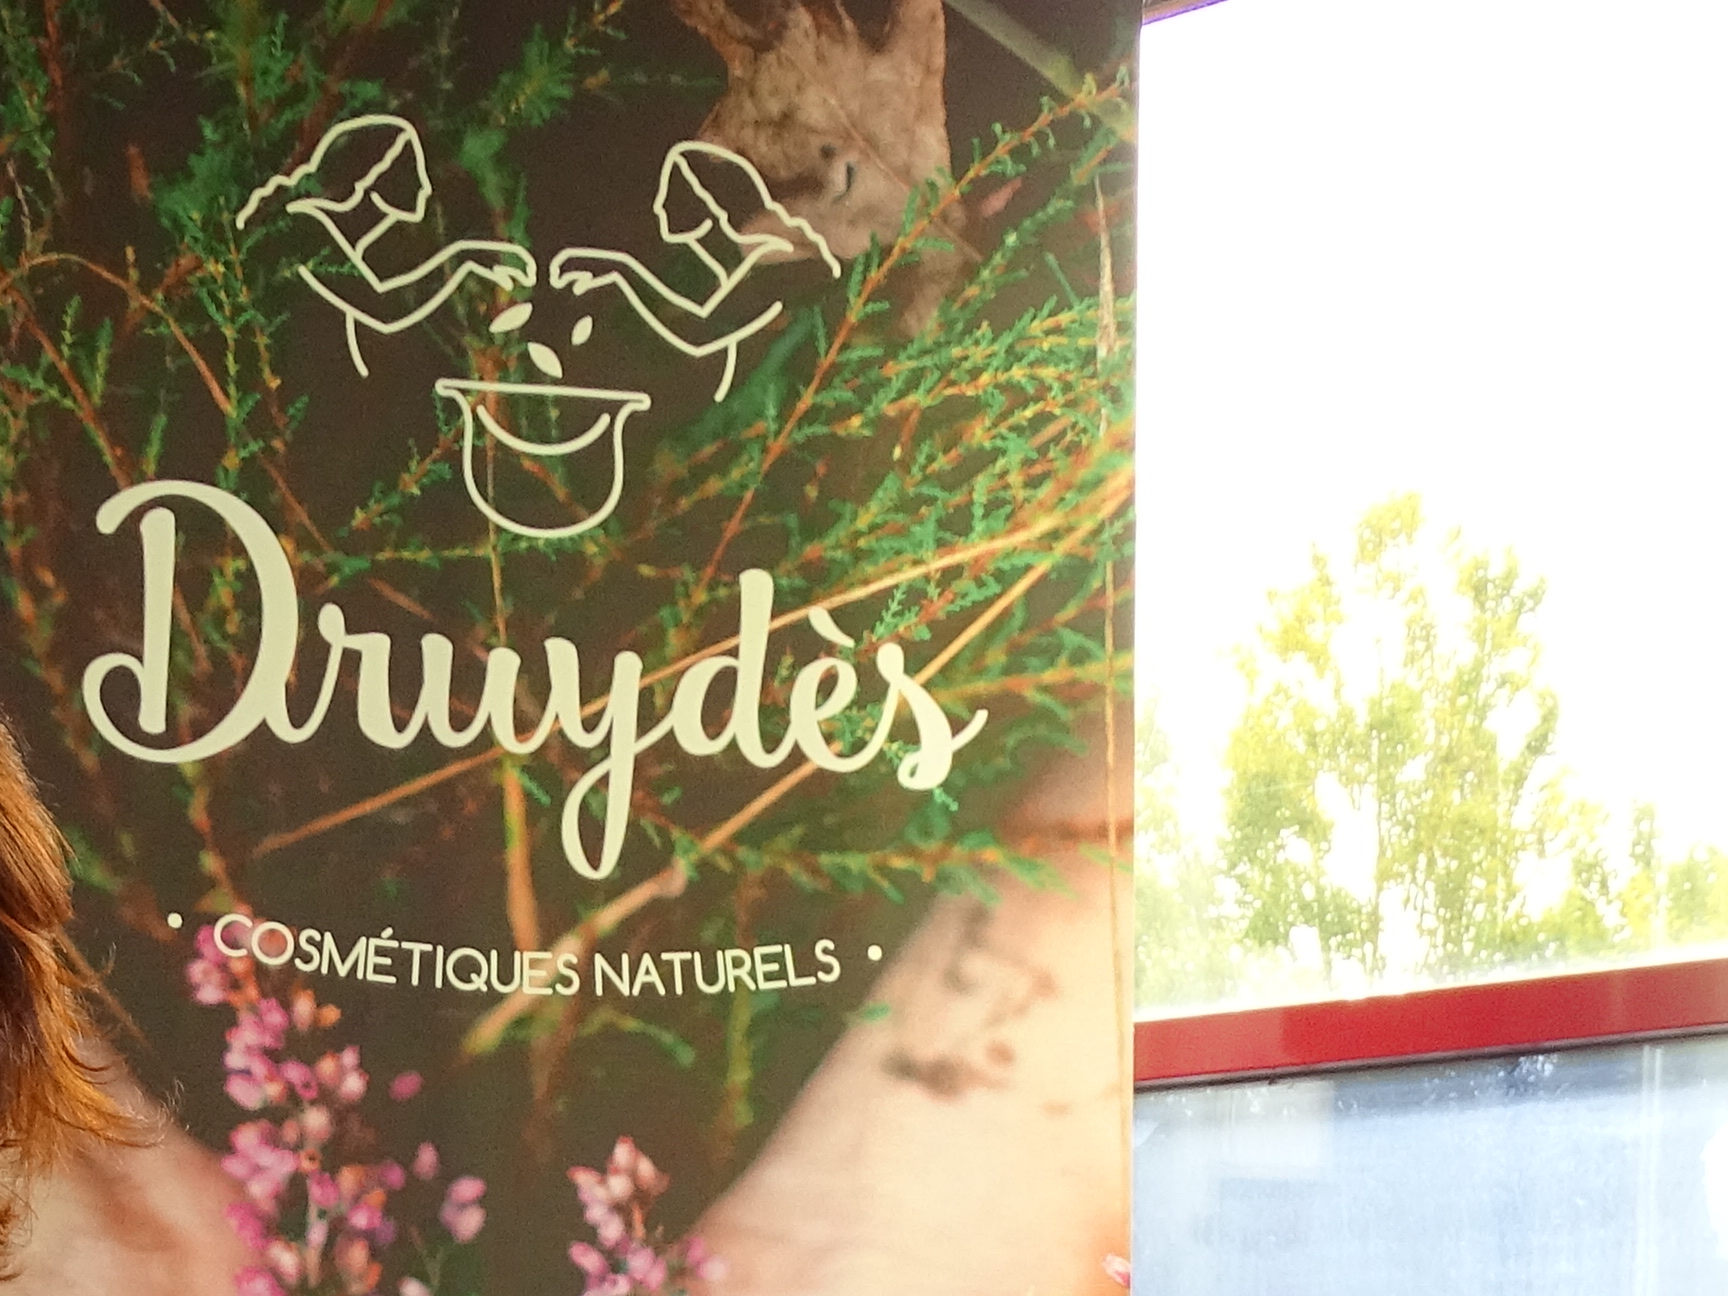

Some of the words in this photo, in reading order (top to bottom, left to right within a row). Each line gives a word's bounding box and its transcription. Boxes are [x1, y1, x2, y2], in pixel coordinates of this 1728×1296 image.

[82, 480, 988, 879] Druydès
[212, 912, 582, 996] COSMÉTIQUES
[593, 941, 841, 996] NATURELS
